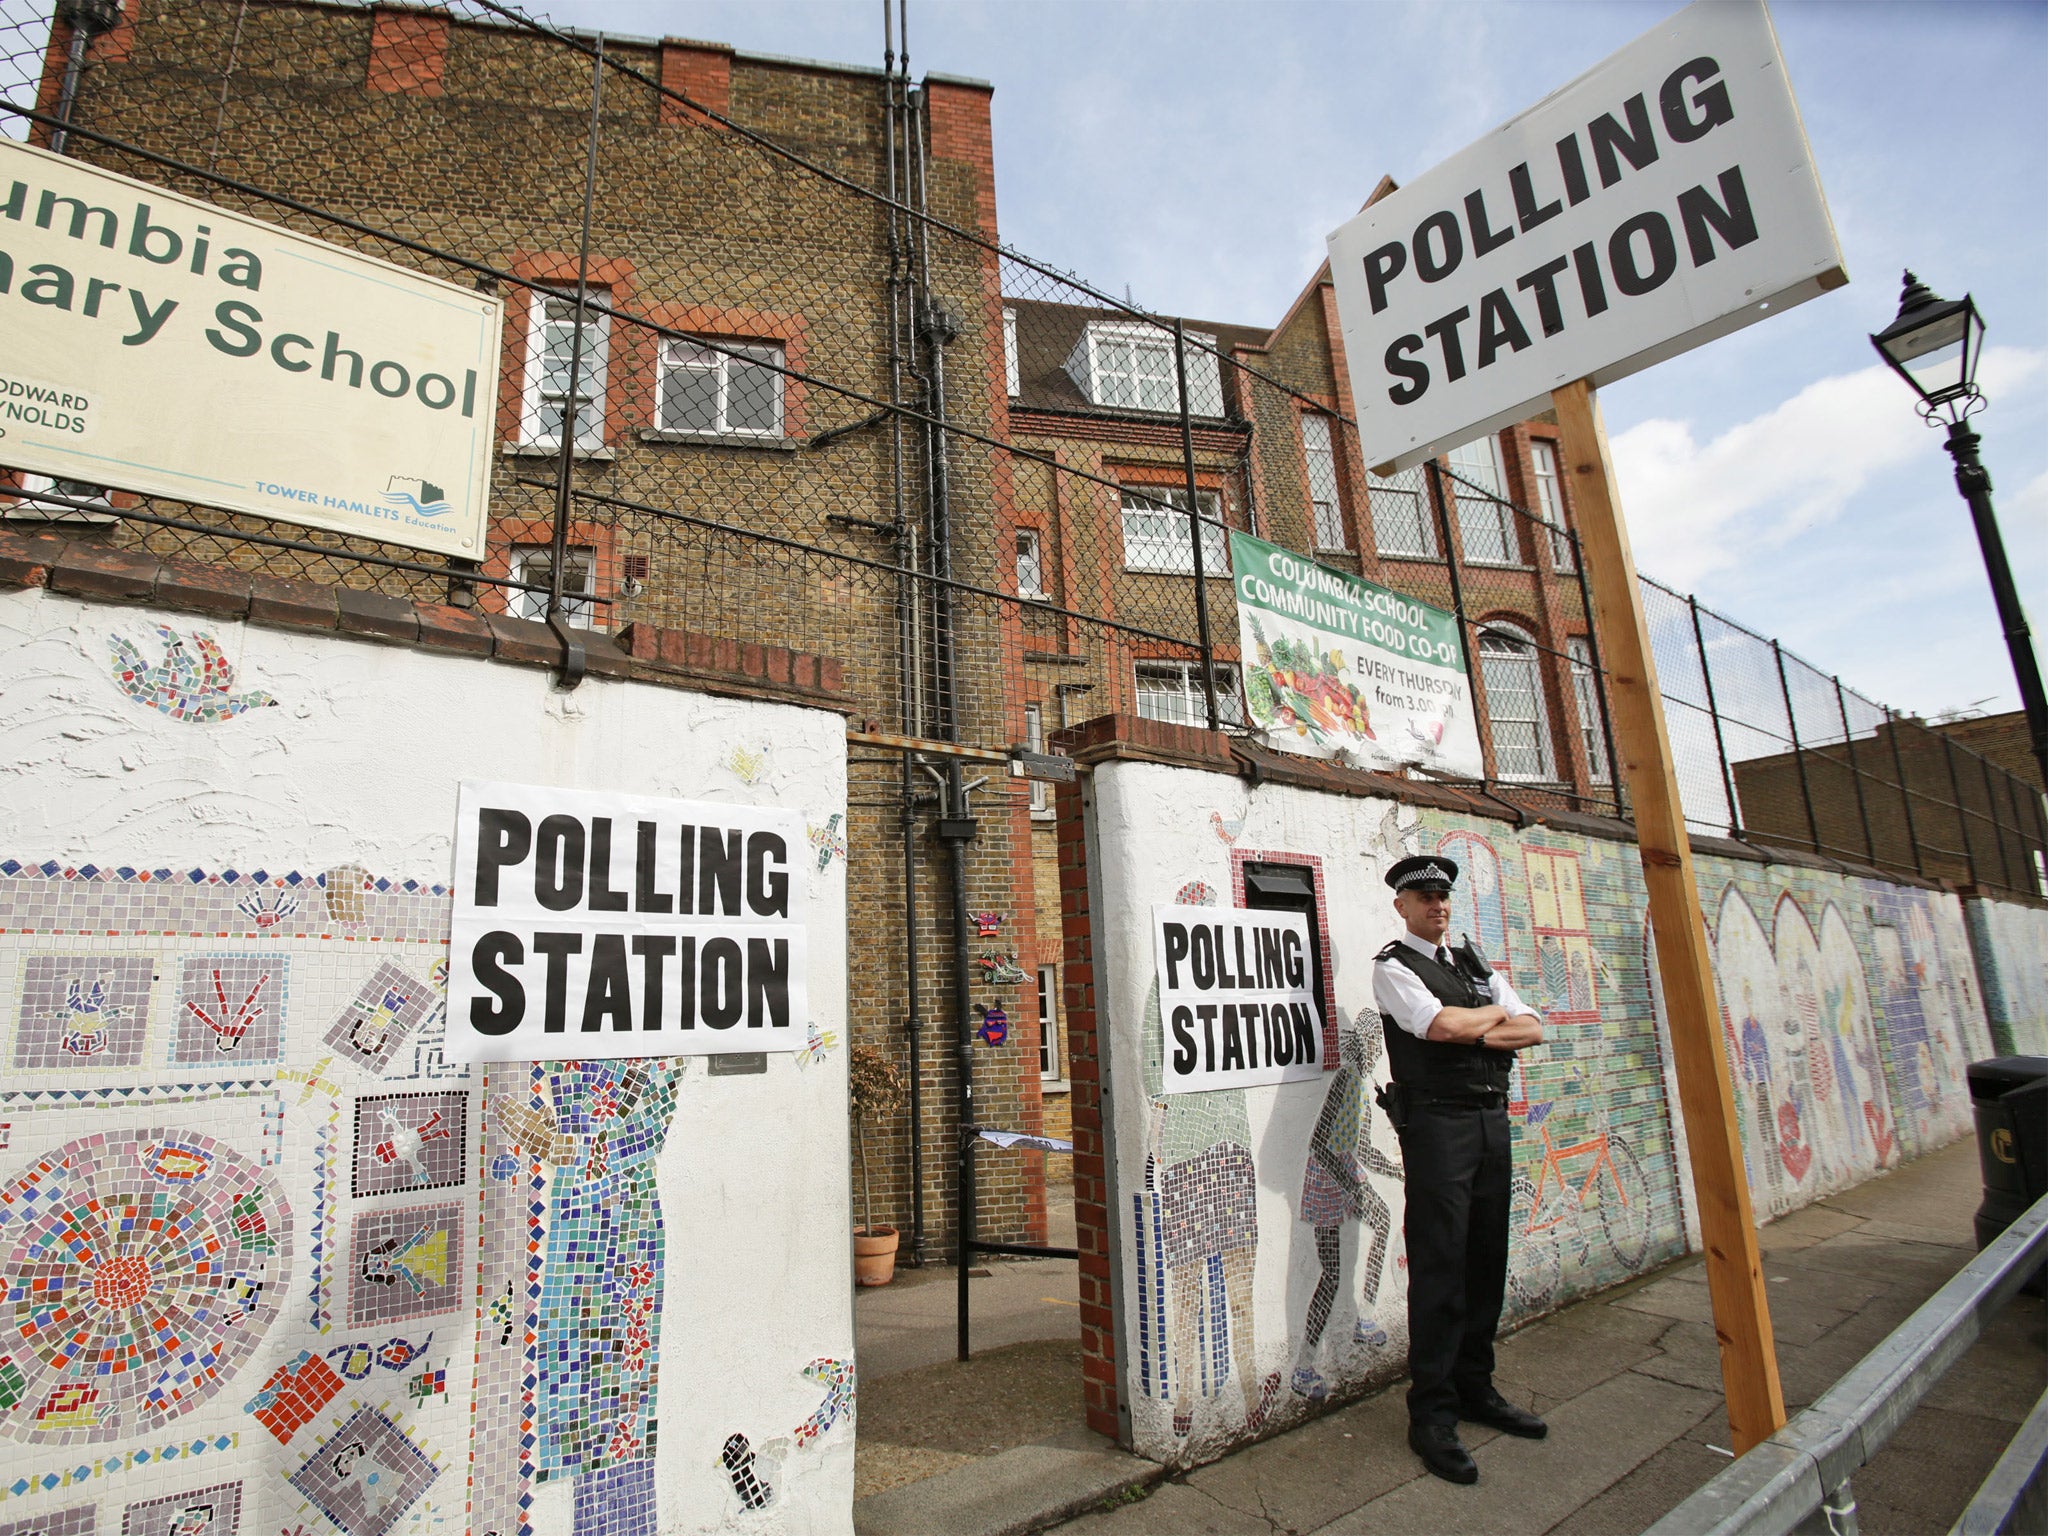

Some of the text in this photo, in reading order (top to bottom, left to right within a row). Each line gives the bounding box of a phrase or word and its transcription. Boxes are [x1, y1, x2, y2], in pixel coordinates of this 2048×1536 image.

[1362, 56, 1734, 315] POLLING
[1384, 164, 1759, 406] STATION
[0, 252, 477, 419] ary School
[0, 400, 85, 433] NOLDS
[256, 481, 457, 534] TOWER HAMLETS Education
[1240, 574, 1360, 634] COMMUNITY
[1362, 616, 1406, 651] FOOD
[1364, 589, 1429, 631] SCHOOL
[1357, 656, 1396, 684] EVERY
[1375, 685, 1405, 709] from
[474, 807, 789, 919] POLLING
[470, 930, 790, 1036] STATION
[1163, 922, 1305, 991] POLLING
[1171, 1002, 1316, 1076] STATION
